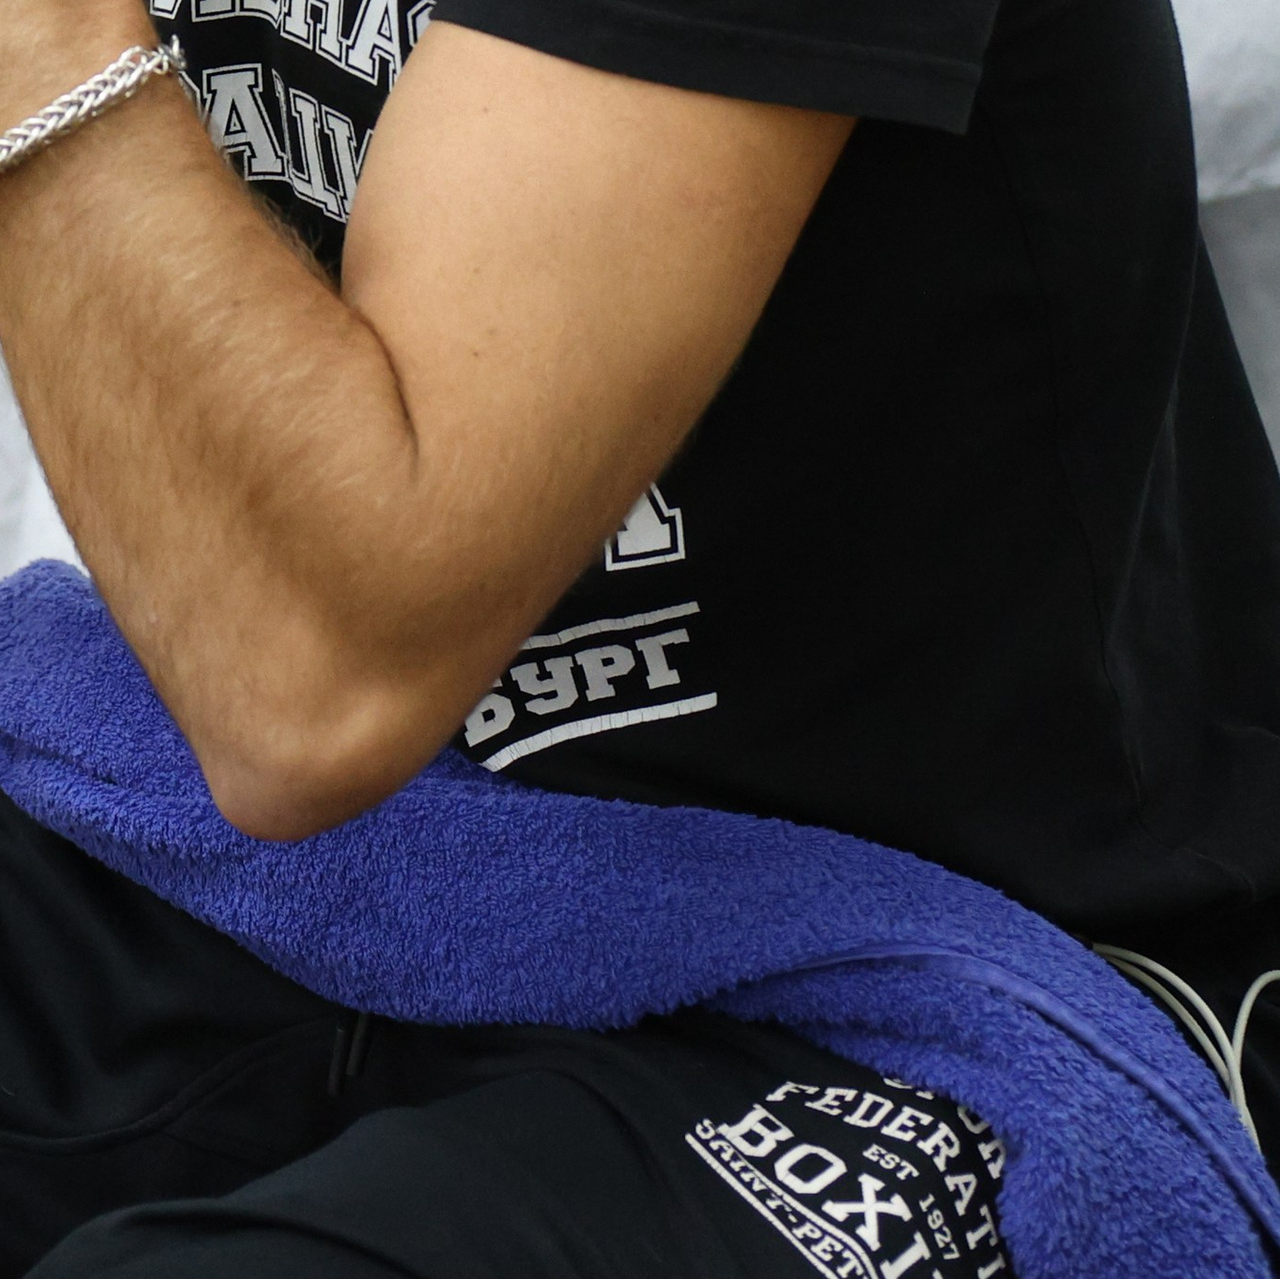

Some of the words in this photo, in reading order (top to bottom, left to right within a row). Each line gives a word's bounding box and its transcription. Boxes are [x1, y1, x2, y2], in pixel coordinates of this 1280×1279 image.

[694, 1118, 869, 1279] SAINT-PET
[717, 1102, 944, 1279] BOXI
[862, 1143, 919, 1181] EST
[918, 1192, 961, 1261] 1927
